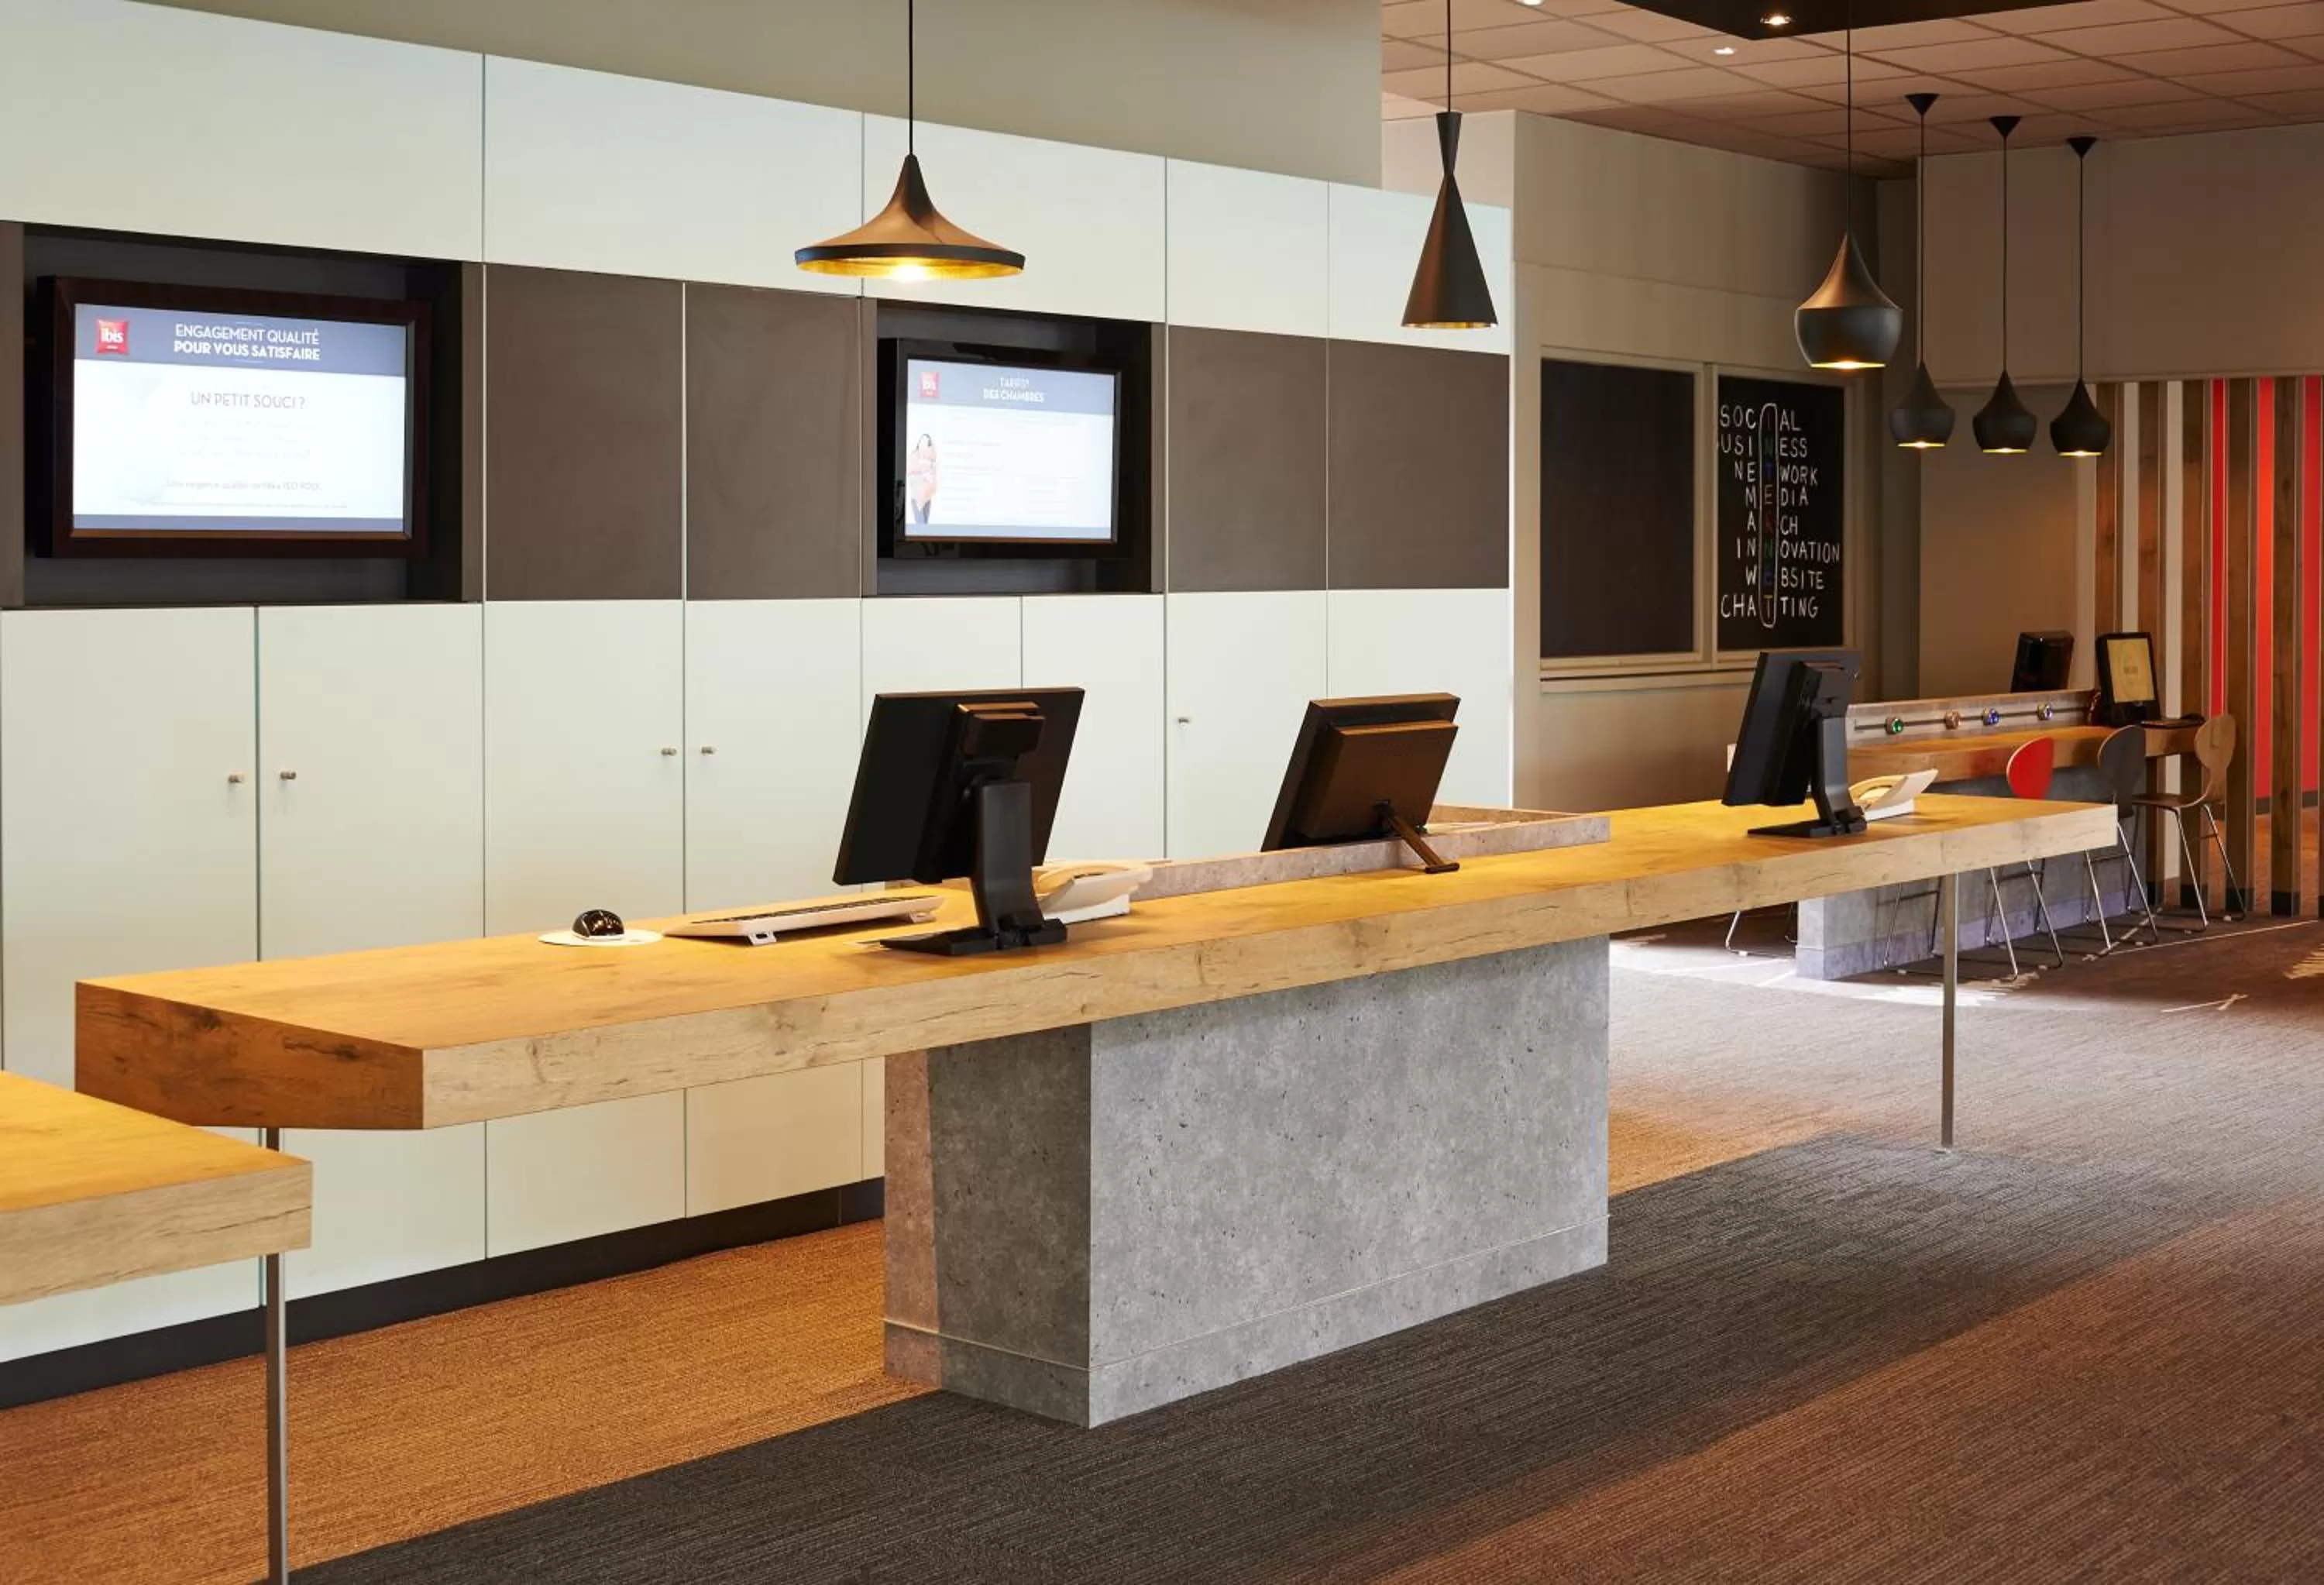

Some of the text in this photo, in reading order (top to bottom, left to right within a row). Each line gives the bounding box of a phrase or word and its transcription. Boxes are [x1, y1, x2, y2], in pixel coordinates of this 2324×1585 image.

[101, 328, 124, 343] ibis
[174, 323, 320, 346] ENGAGEMENT QUALITÉ
[174, 340, 321, 361] POUR VOUS SATISFAIRE
[190, 390, 212, 407] UN
[214, 391, 251, 407] PETIT
[253, 394, 297, 409] SOUCI
[1717, 433, 1808, 458] USINESS
